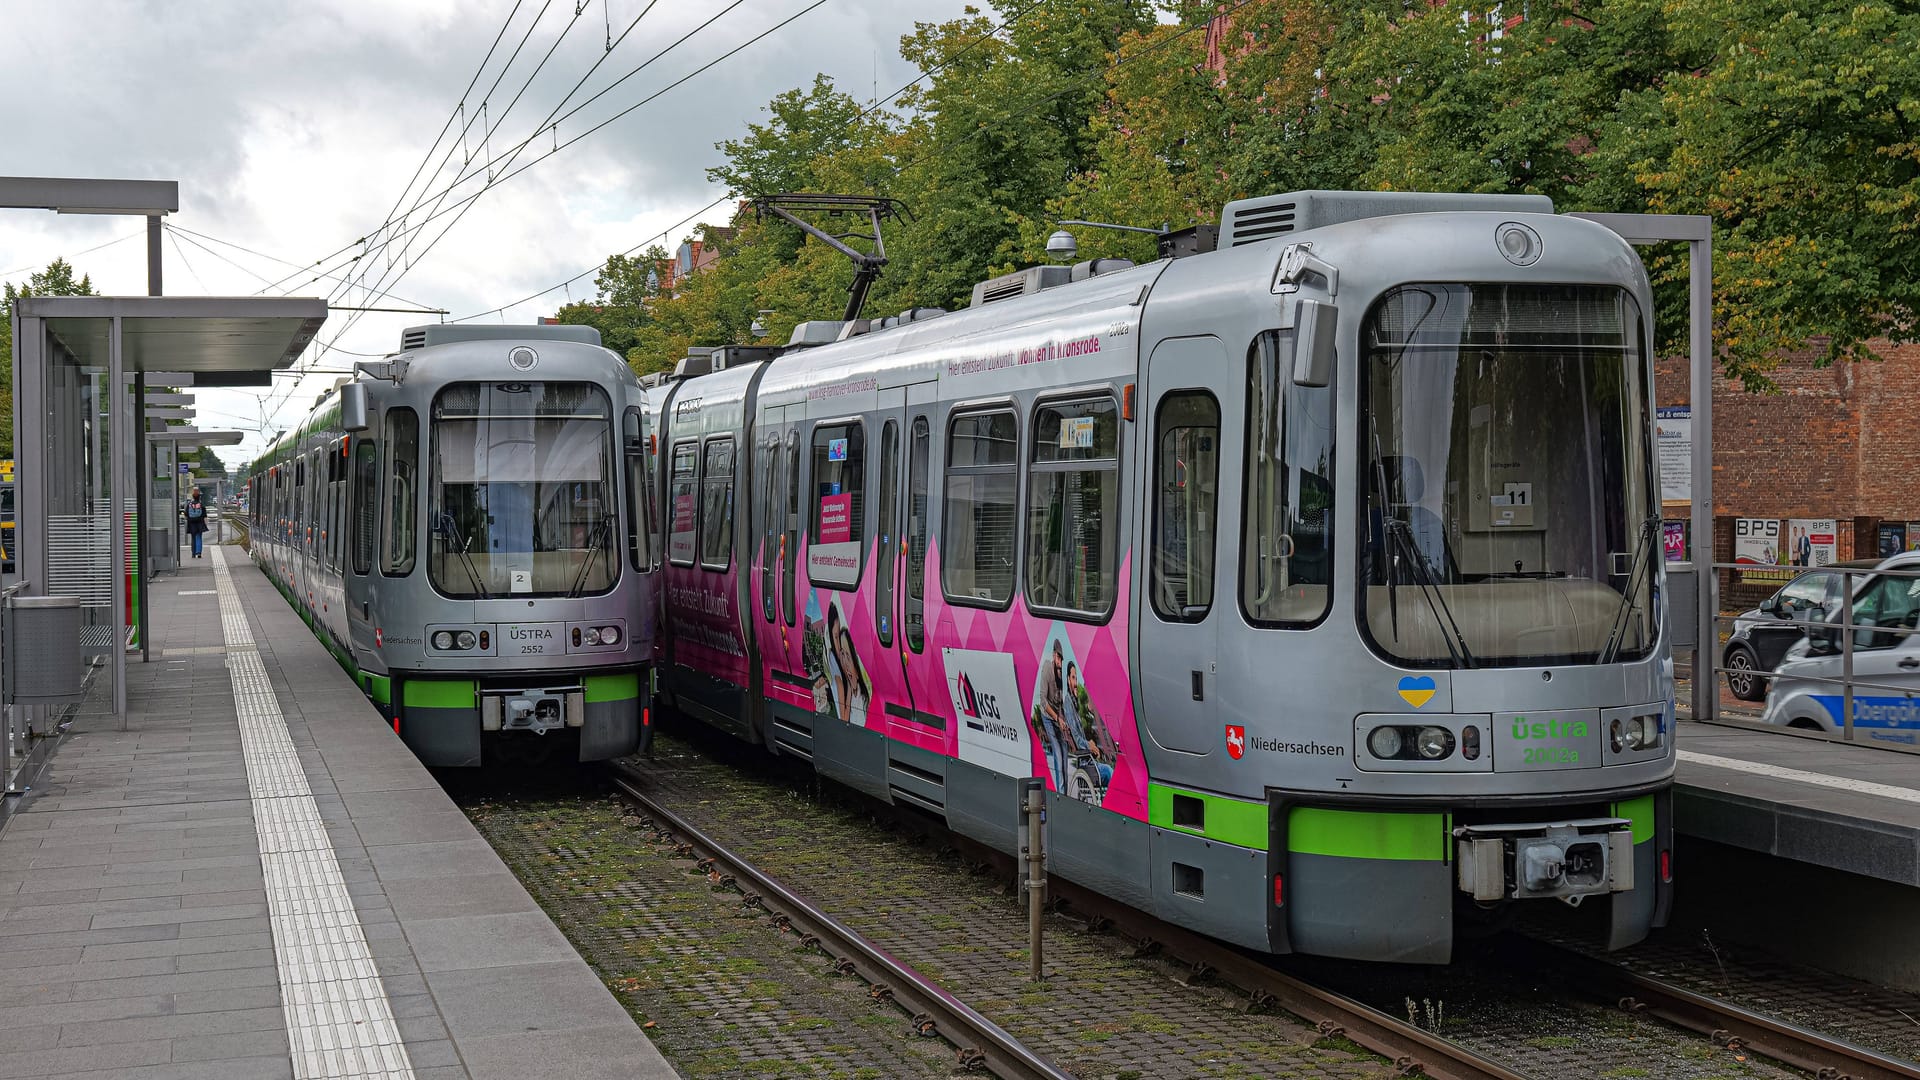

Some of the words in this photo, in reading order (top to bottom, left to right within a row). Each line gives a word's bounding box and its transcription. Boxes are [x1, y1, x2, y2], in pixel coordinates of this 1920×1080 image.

[1017, 346, 1046, 366] Wohnen
[1048, 341, 1056, 361] in
[1057, 334, 1101, 359] Kronsrode.
[1508, 491, 1526, 505] 11
[1737, 520, 1778, 536] BPS
[516, 574, 524, 582] 2
[510, 626, 553, 640] ÜSTRA
[521, 645, 544, 654] 2552
[976, 691, 1001, 720] KSG
[984, 721, 1019, 743] HANNOVER
[1512, 716, 1588, 740] üstra
[1251, 736, 1345, 757] Niedersachsen
[1523, 746, 1579, 765] 2002a
